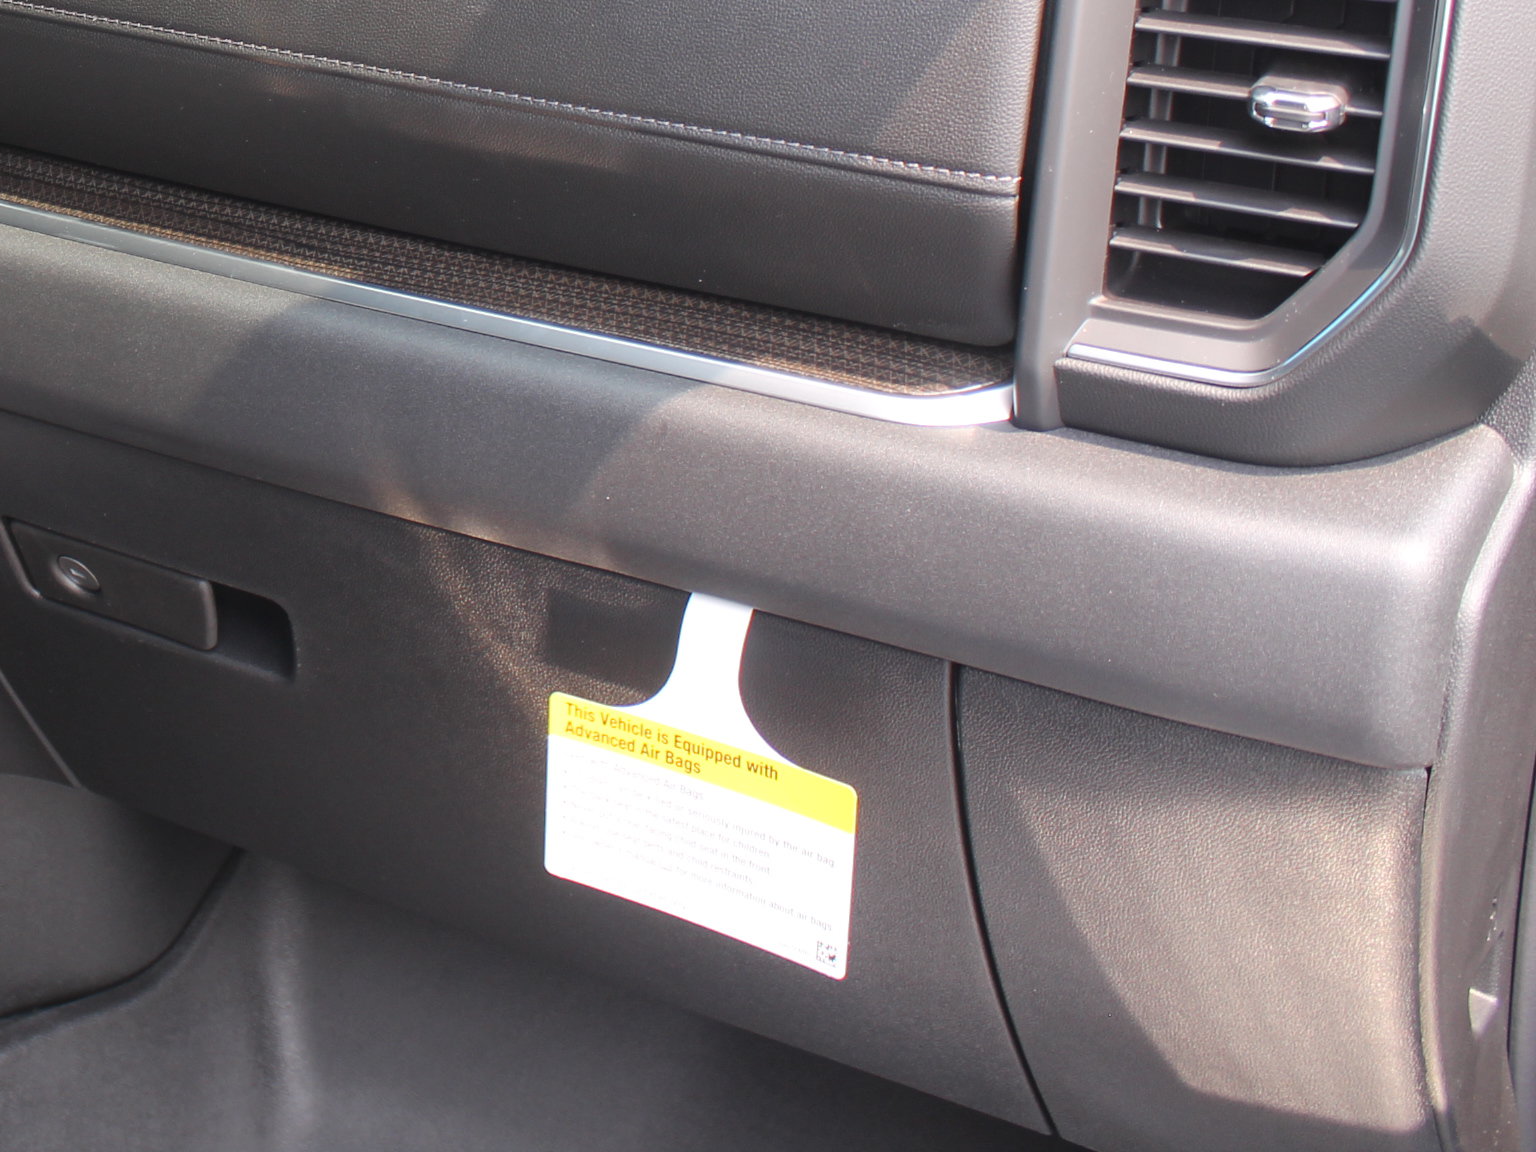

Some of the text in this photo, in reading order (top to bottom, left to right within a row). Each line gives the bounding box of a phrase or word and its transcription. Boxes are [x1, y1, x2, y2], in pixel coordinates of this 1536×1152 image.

[565, 702, 779, 781] This Vehicle is Equipped with
[565, 721, 702, 774] Advanced Air Bags
[768, 833, 780, 846] by
[783, 840, 798, 851] the
[801, 847, 813, 858] air
[816, 852, 835, 868] bag
[810, 915, 833, 933] bags
